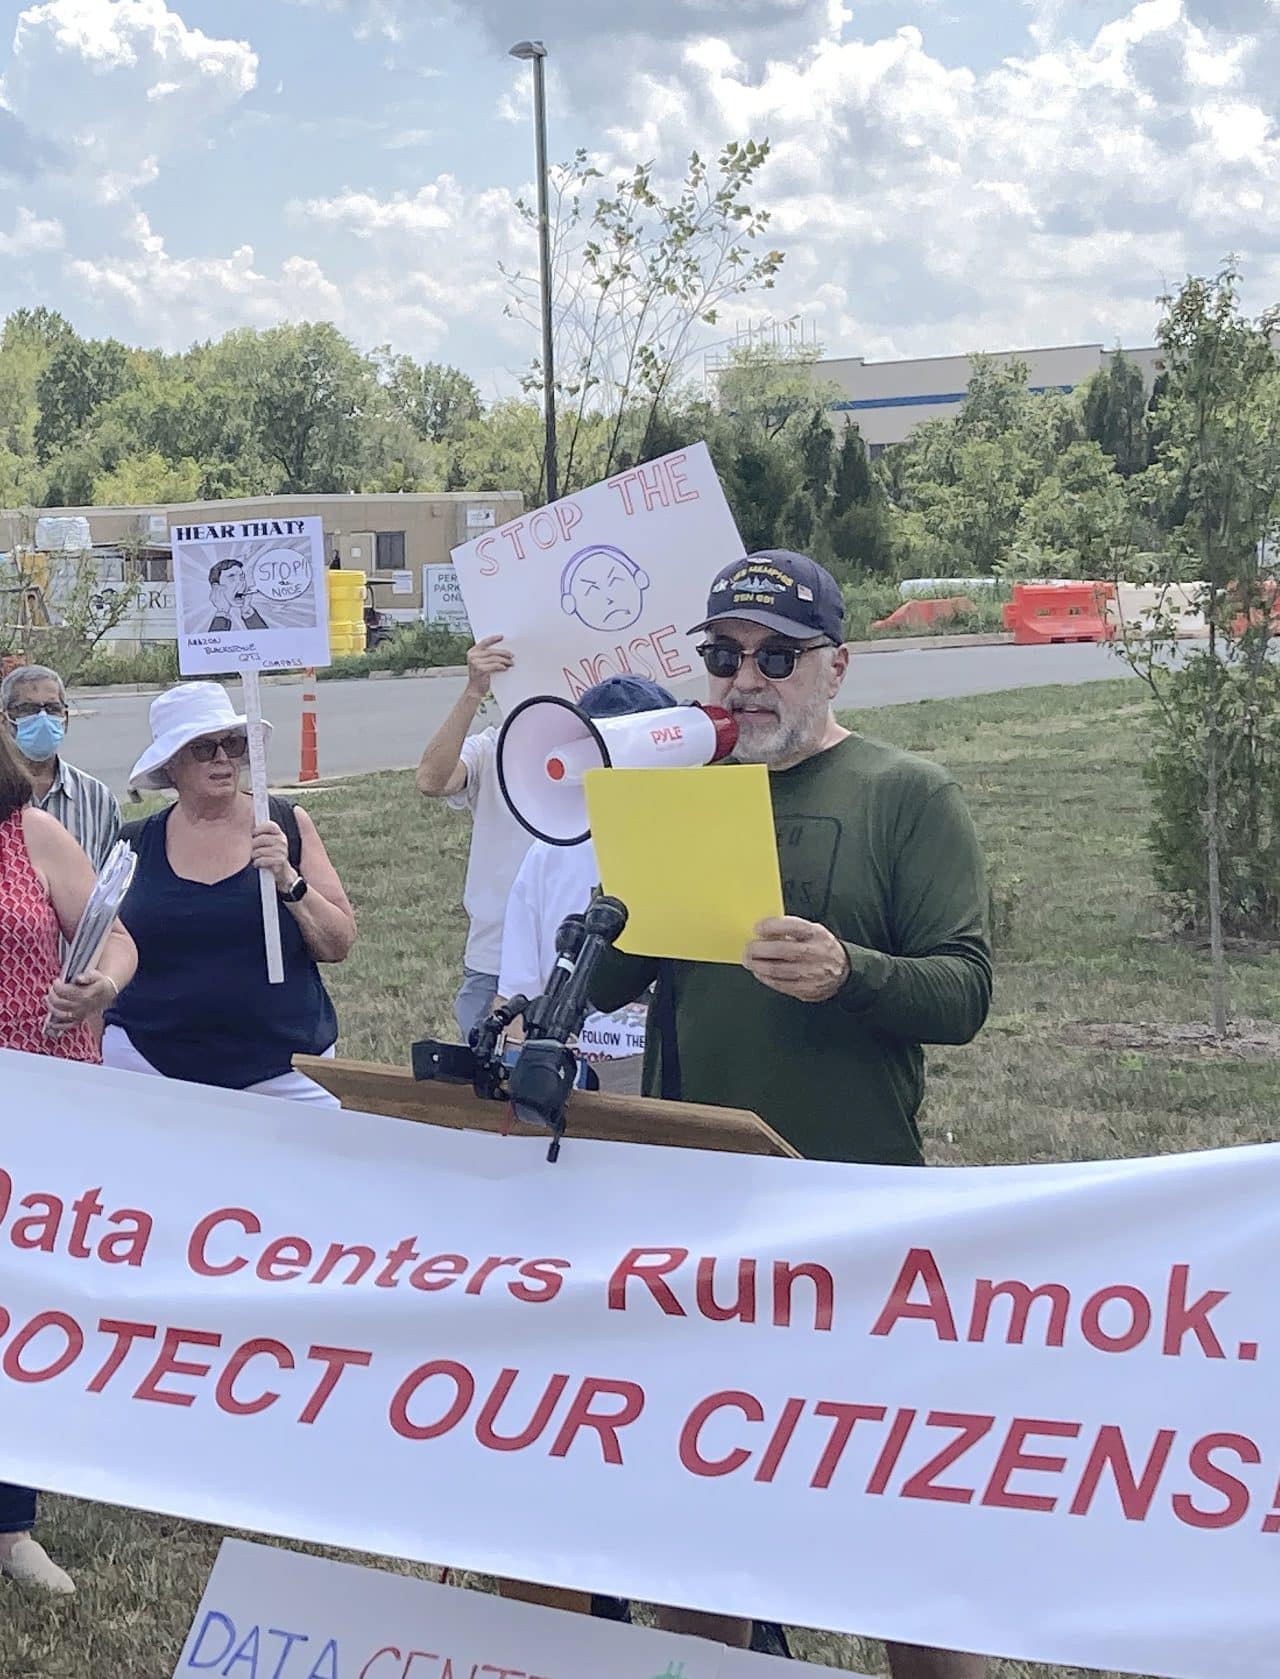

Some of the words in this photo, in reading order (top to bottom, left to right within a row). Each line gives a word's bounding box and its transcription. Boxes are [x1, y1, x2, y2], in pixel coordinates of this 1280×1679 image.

[176, 524, 236, 541] HEAR
[241, 520, 305, 537] THAT?
[475, 502, 583, 576] STOP
[608, 453, 700, 516] THE
[562, 624, 692, 702] NOISE
[651, 726, 683, 744] PYLE
[582, 1030, 620, 1046] FOLLOW
[625, 1033, 646, 1047] THE
[187, 1207, 571, 1303] Centers
[607, 1247, 834, 1331] Run
[870, 1247, 1258, 1361] Amok.
[388, 1359, 646, 1465] OUR
[187, 1610, 339, 1679] DATA
